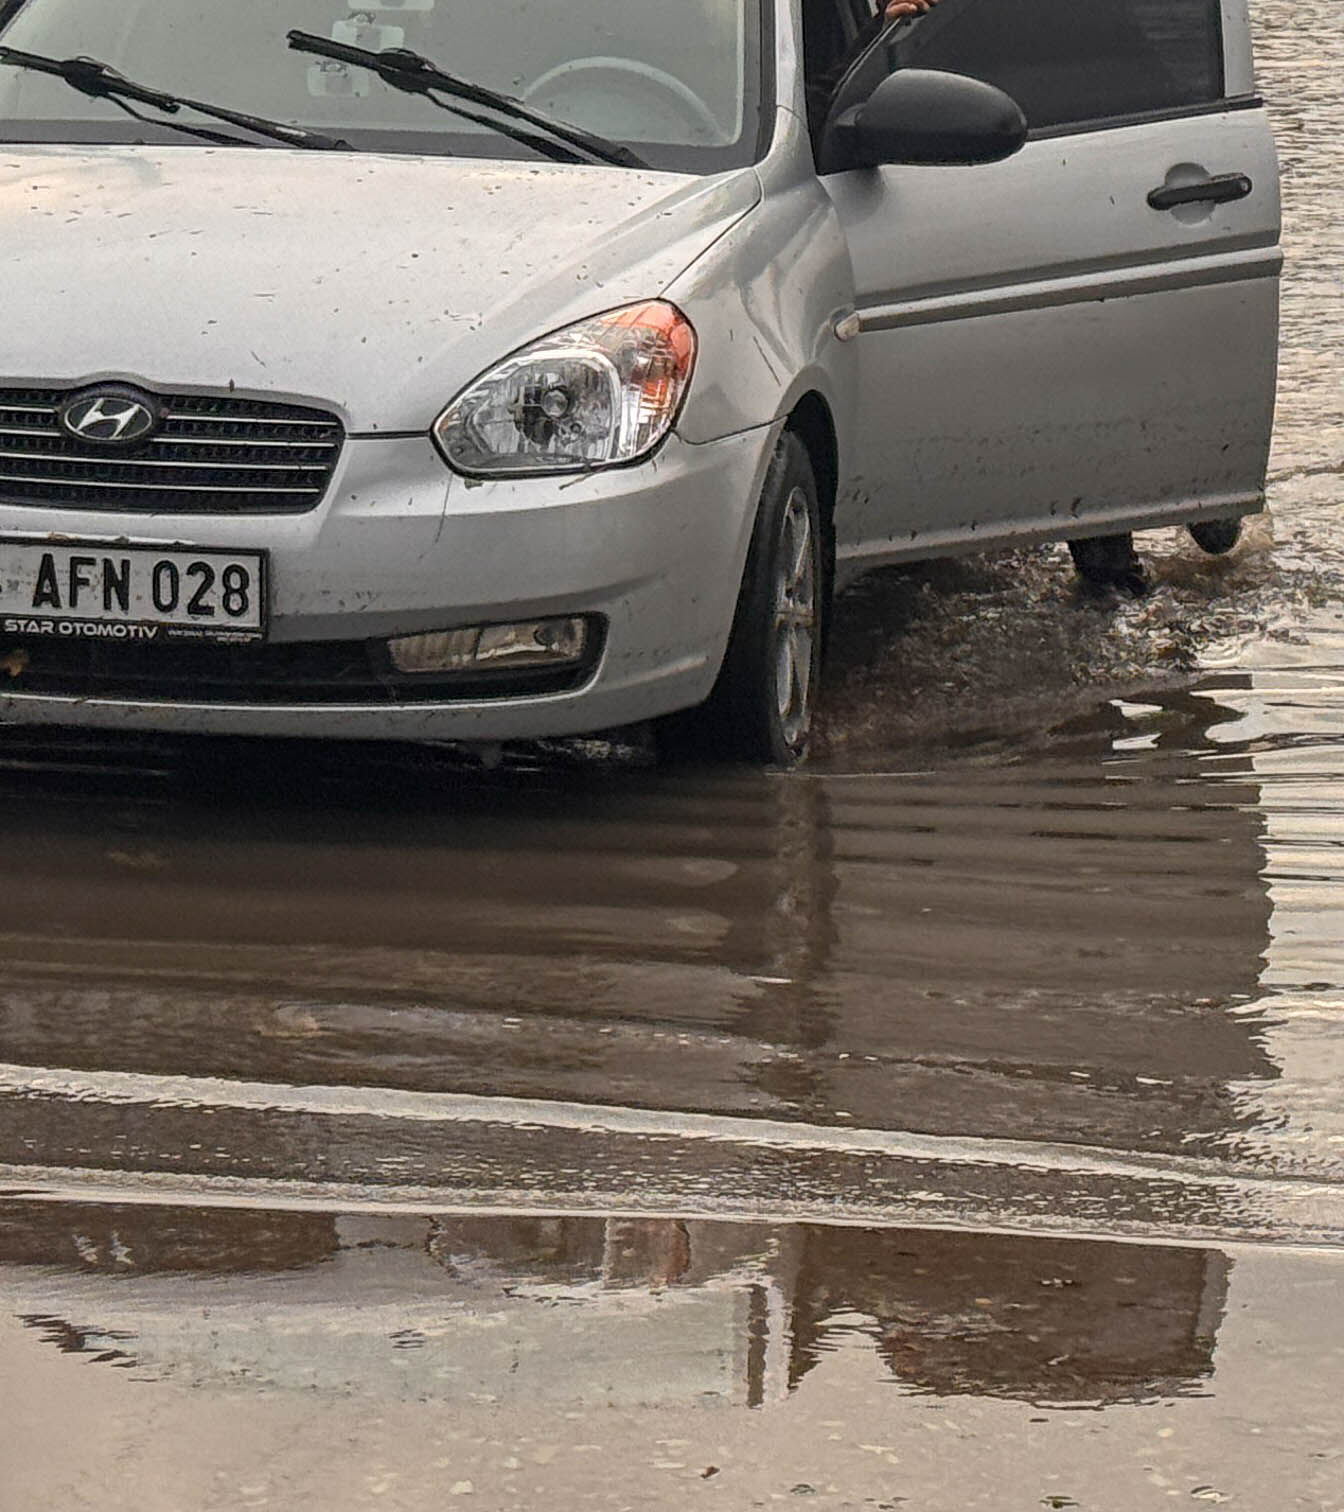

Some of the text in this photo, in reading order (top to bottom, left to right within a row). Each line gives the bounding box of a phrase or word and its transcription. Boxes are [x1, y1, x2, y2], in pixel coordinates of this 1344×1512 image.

[32, 553, 130, 615] AFN
[152, 560, 250, 616] 028
[4, 619, 54, 634] STAR
[58, 621, 158, 639] OTOMOTIV
